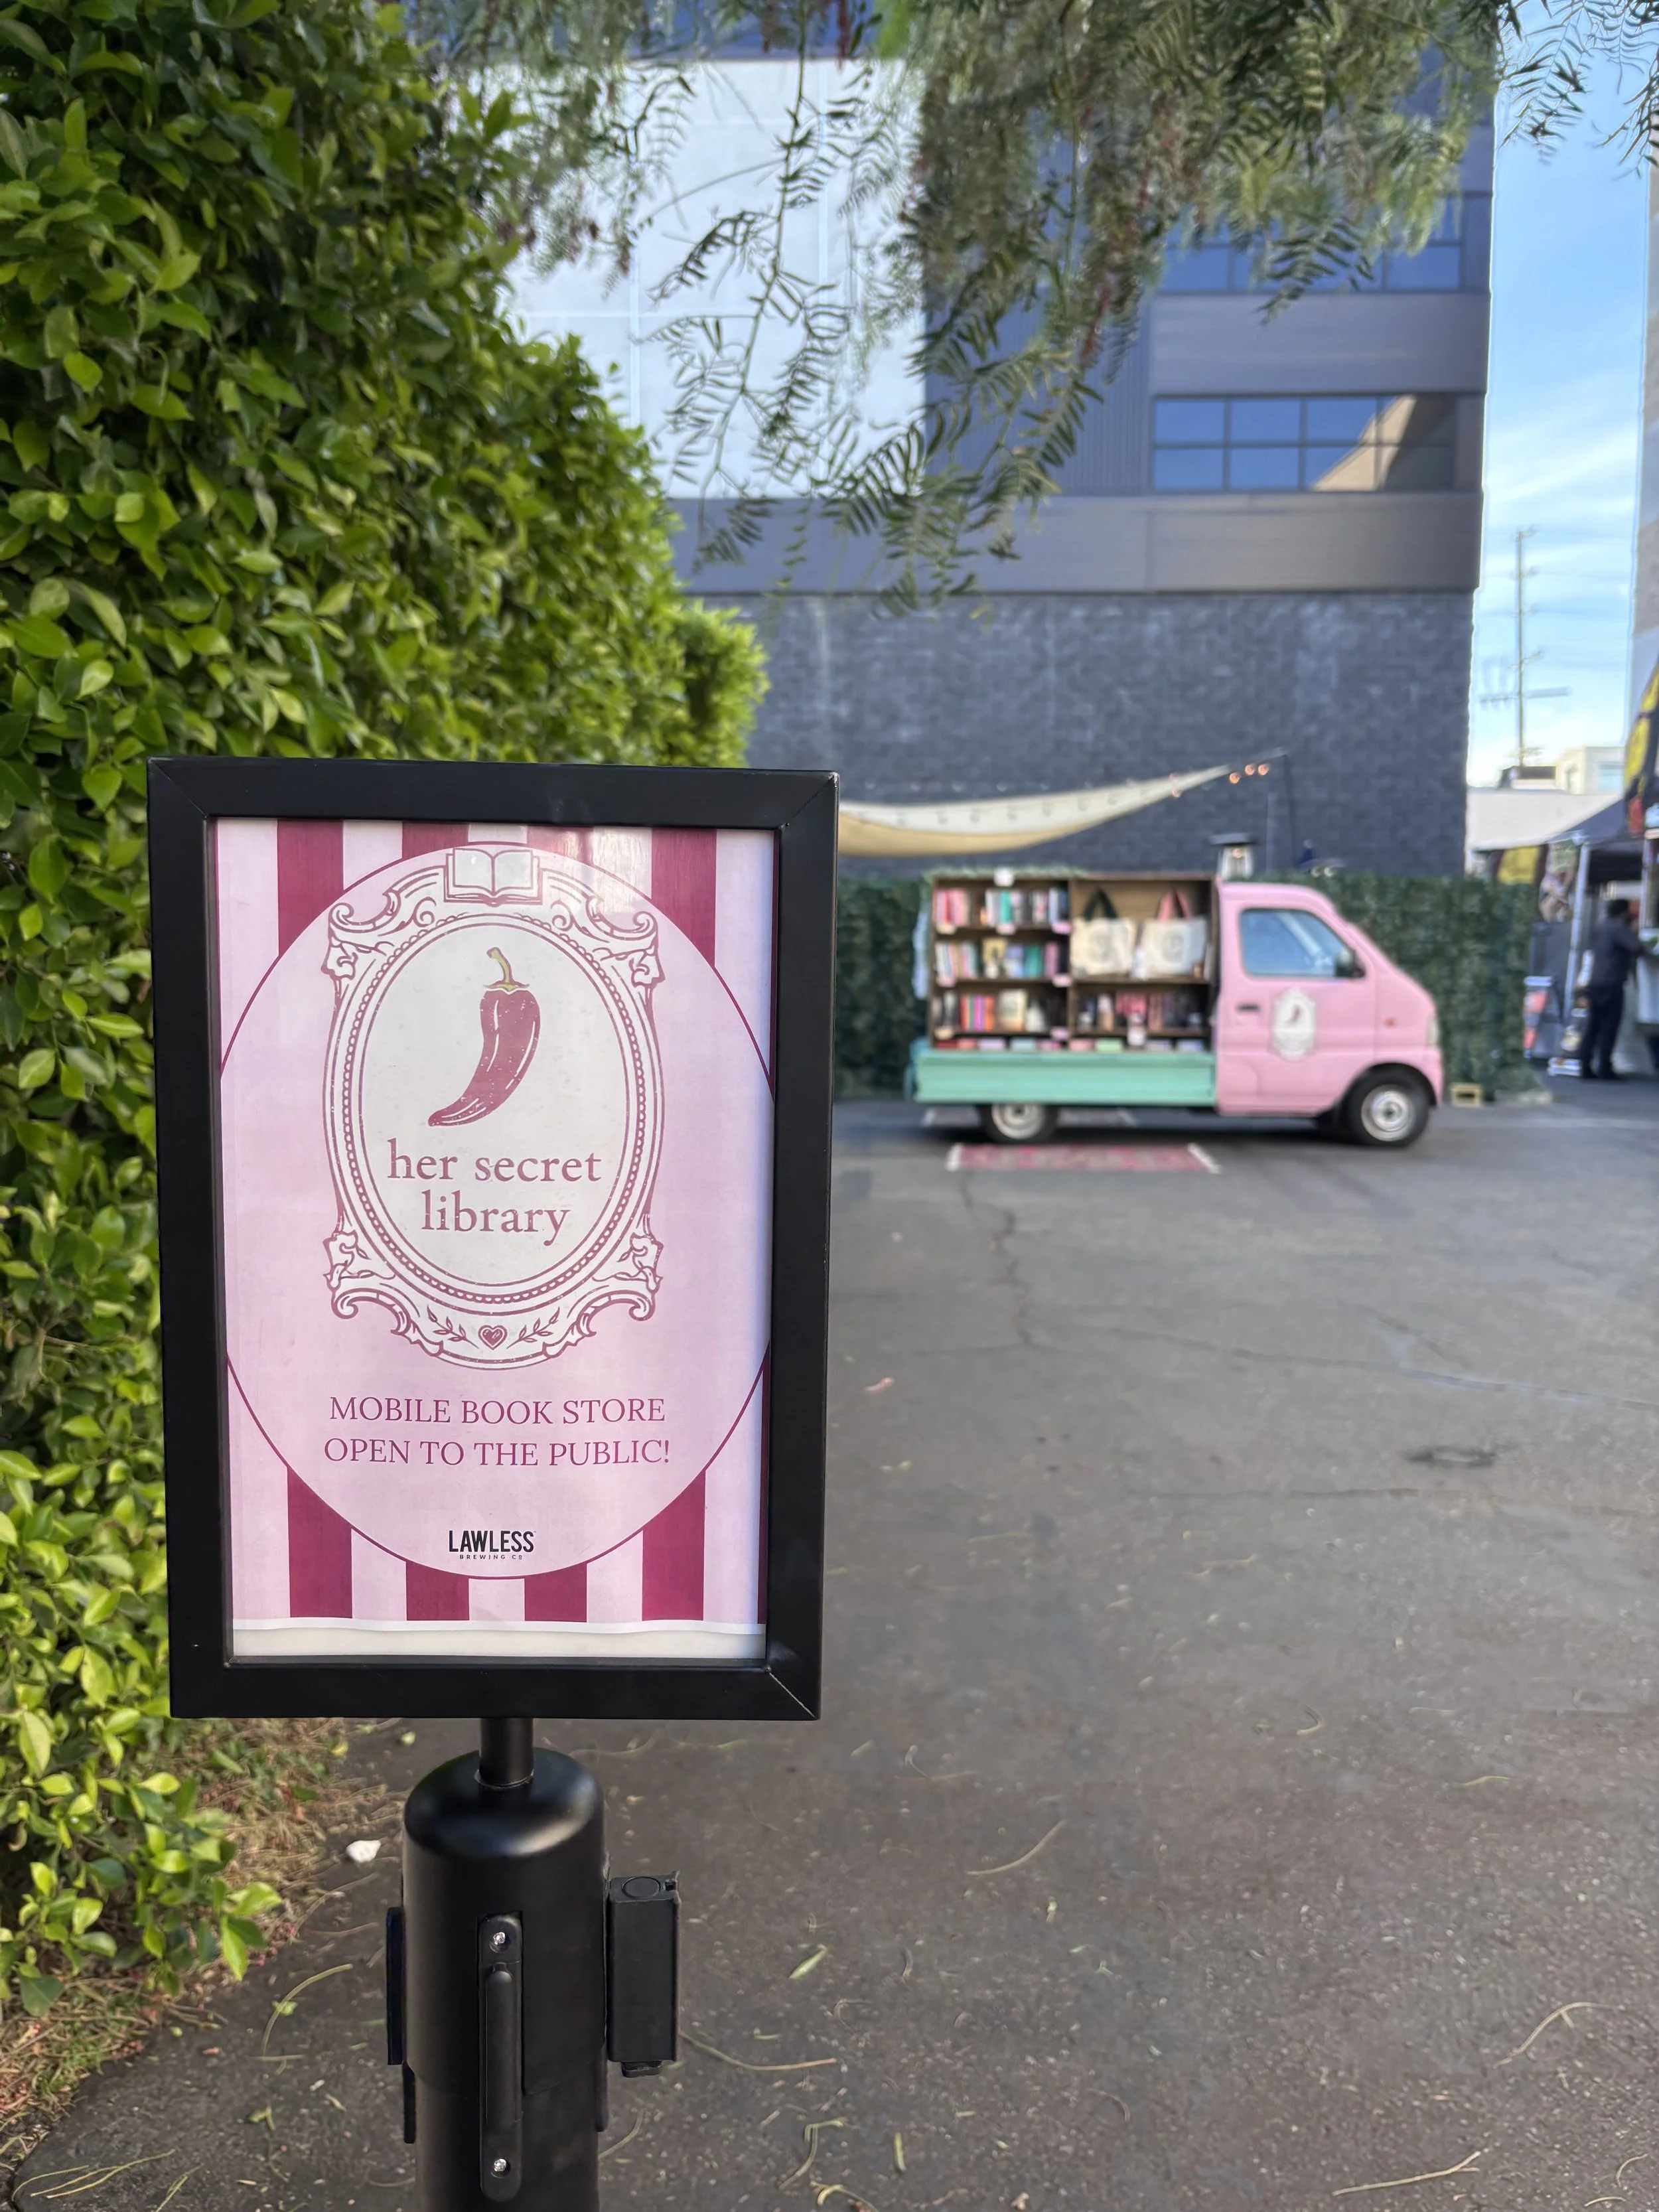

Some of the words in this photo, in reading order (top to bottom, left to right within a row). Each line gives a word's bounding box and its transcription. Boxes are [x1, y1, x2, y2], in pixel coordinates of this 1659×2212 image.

[387, 1138, 458, 1180] her
[474, 1153, 602, 1182] secret
[421, 1189, 571, 1246] library
[330, 1396, 451, 1423] MOBILE
[461, 1400, 553, 1425] BOOK
[563, 1398, 665, 1424] STORE
[324, 1438, 411, 1464] OPEN
[419, 1441, 465, 1465] TO
[474, 1442, 538, 1466] THE
[549, 1439, 670, 1466] PUBLIC!
[449, 1530, 534, 1553] LAWLESS
